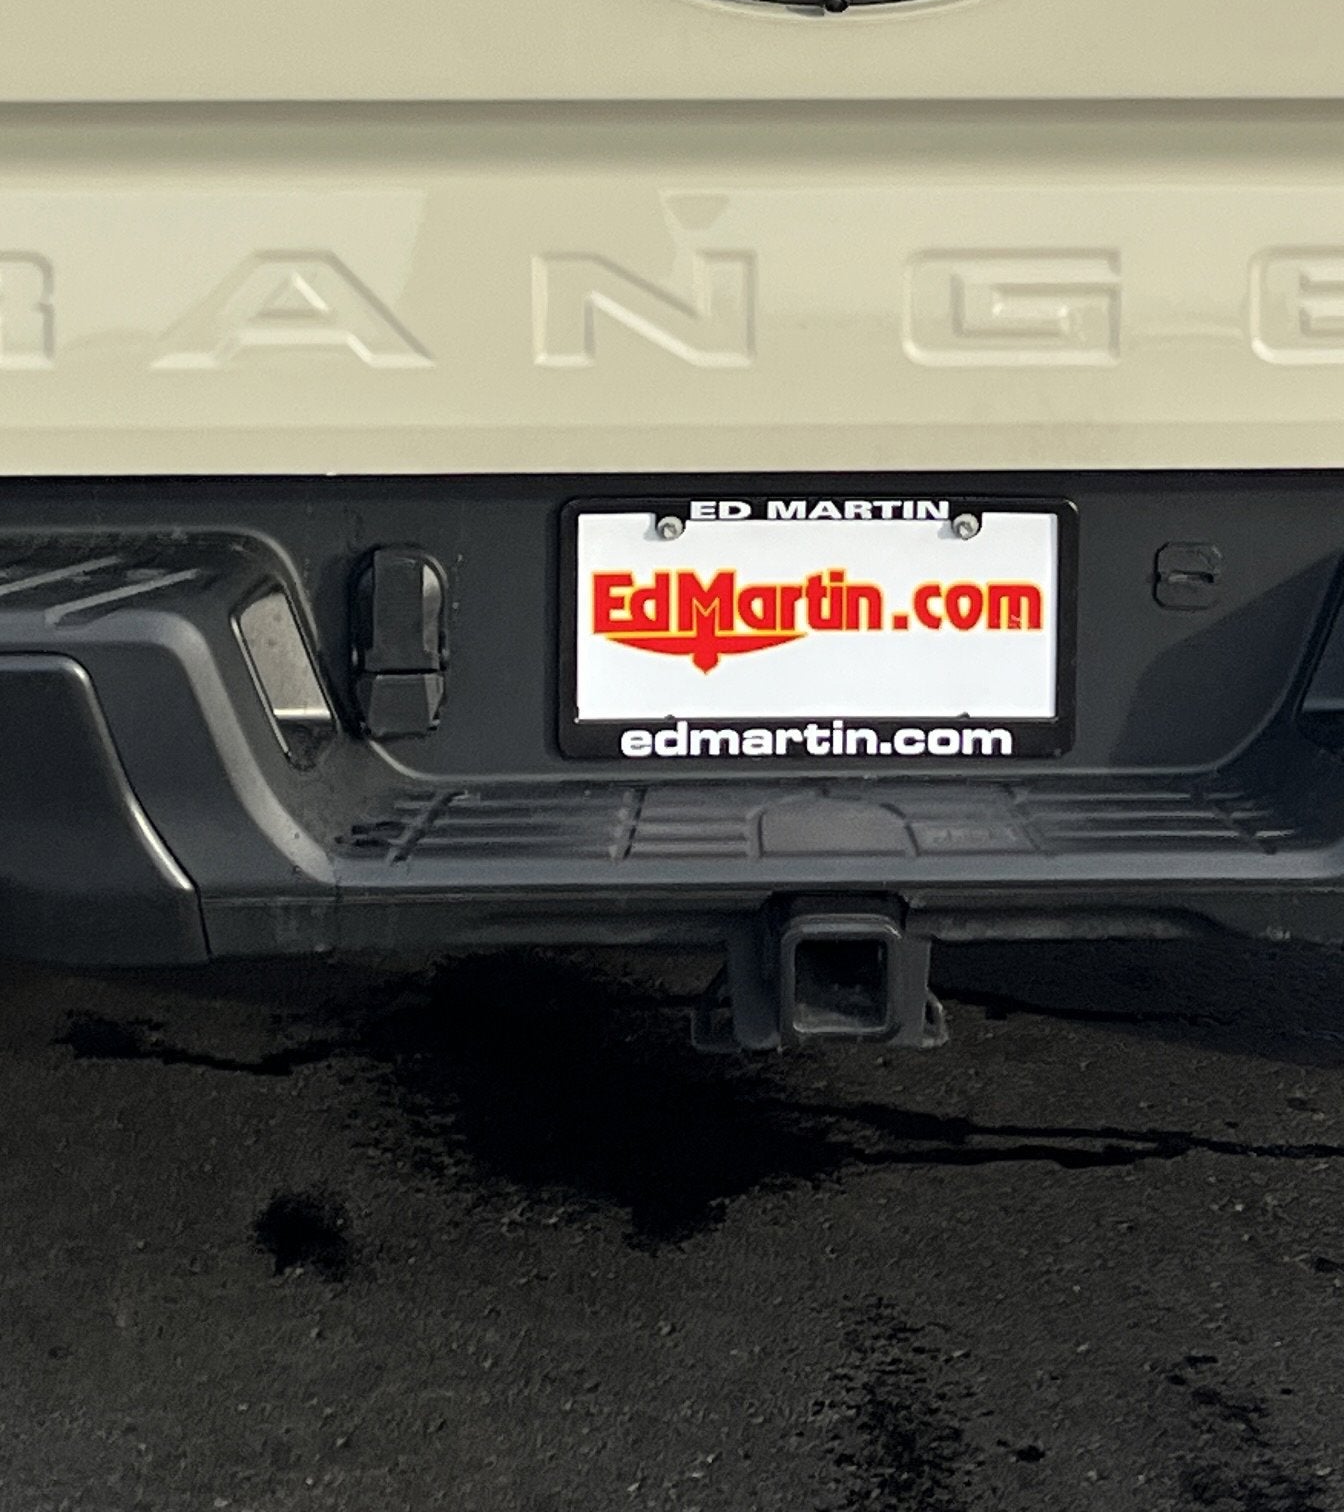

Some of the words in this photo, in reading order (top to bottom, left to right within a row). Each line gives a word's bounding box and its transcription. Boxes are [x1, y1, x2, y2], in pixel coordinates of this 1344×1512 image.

[690, 500, 751, 520] ED
[766, 500, 950, 521] MARTIN
[620, 720, 1013, 757] edmartin.com
